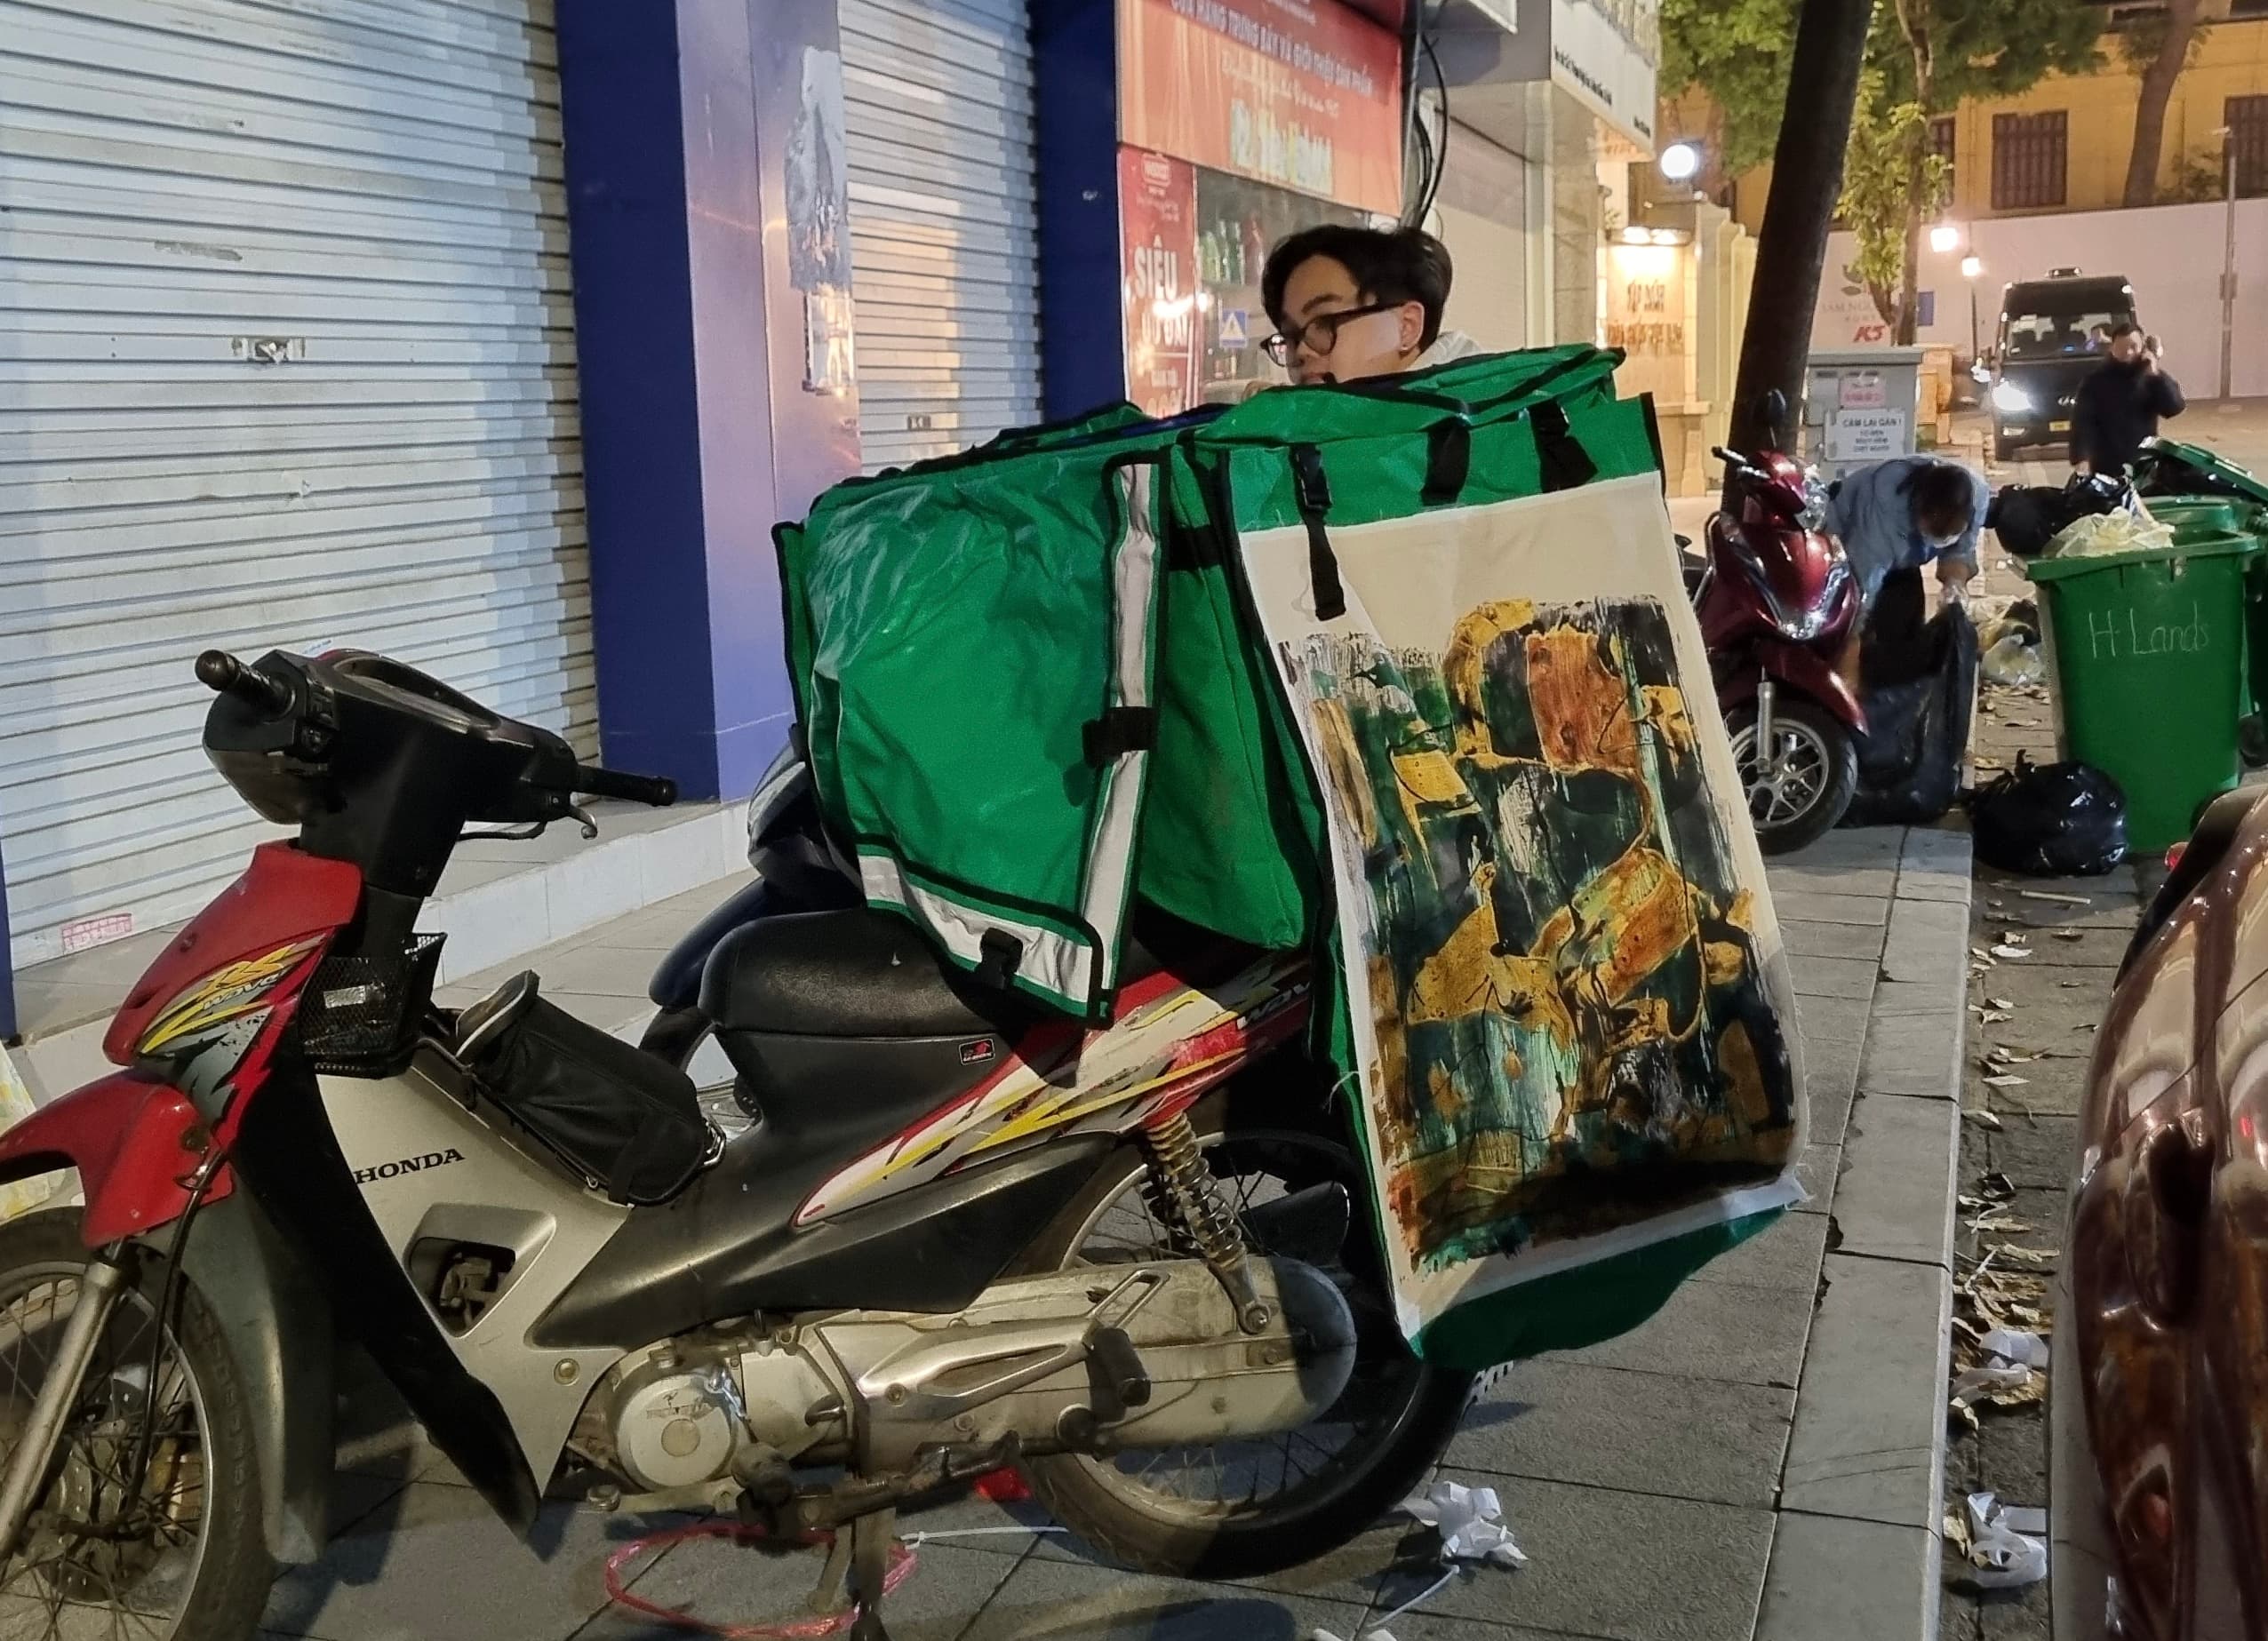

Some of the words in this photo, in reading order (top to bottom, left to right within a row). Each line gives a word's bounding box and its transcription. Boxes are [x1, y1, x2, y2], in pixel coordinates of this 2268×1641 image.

[1134, 234, 1178, 302] SIÊU
[2129, 601, 2210, 656] Lands
[353, 1148, 467, 1185] HONDA
